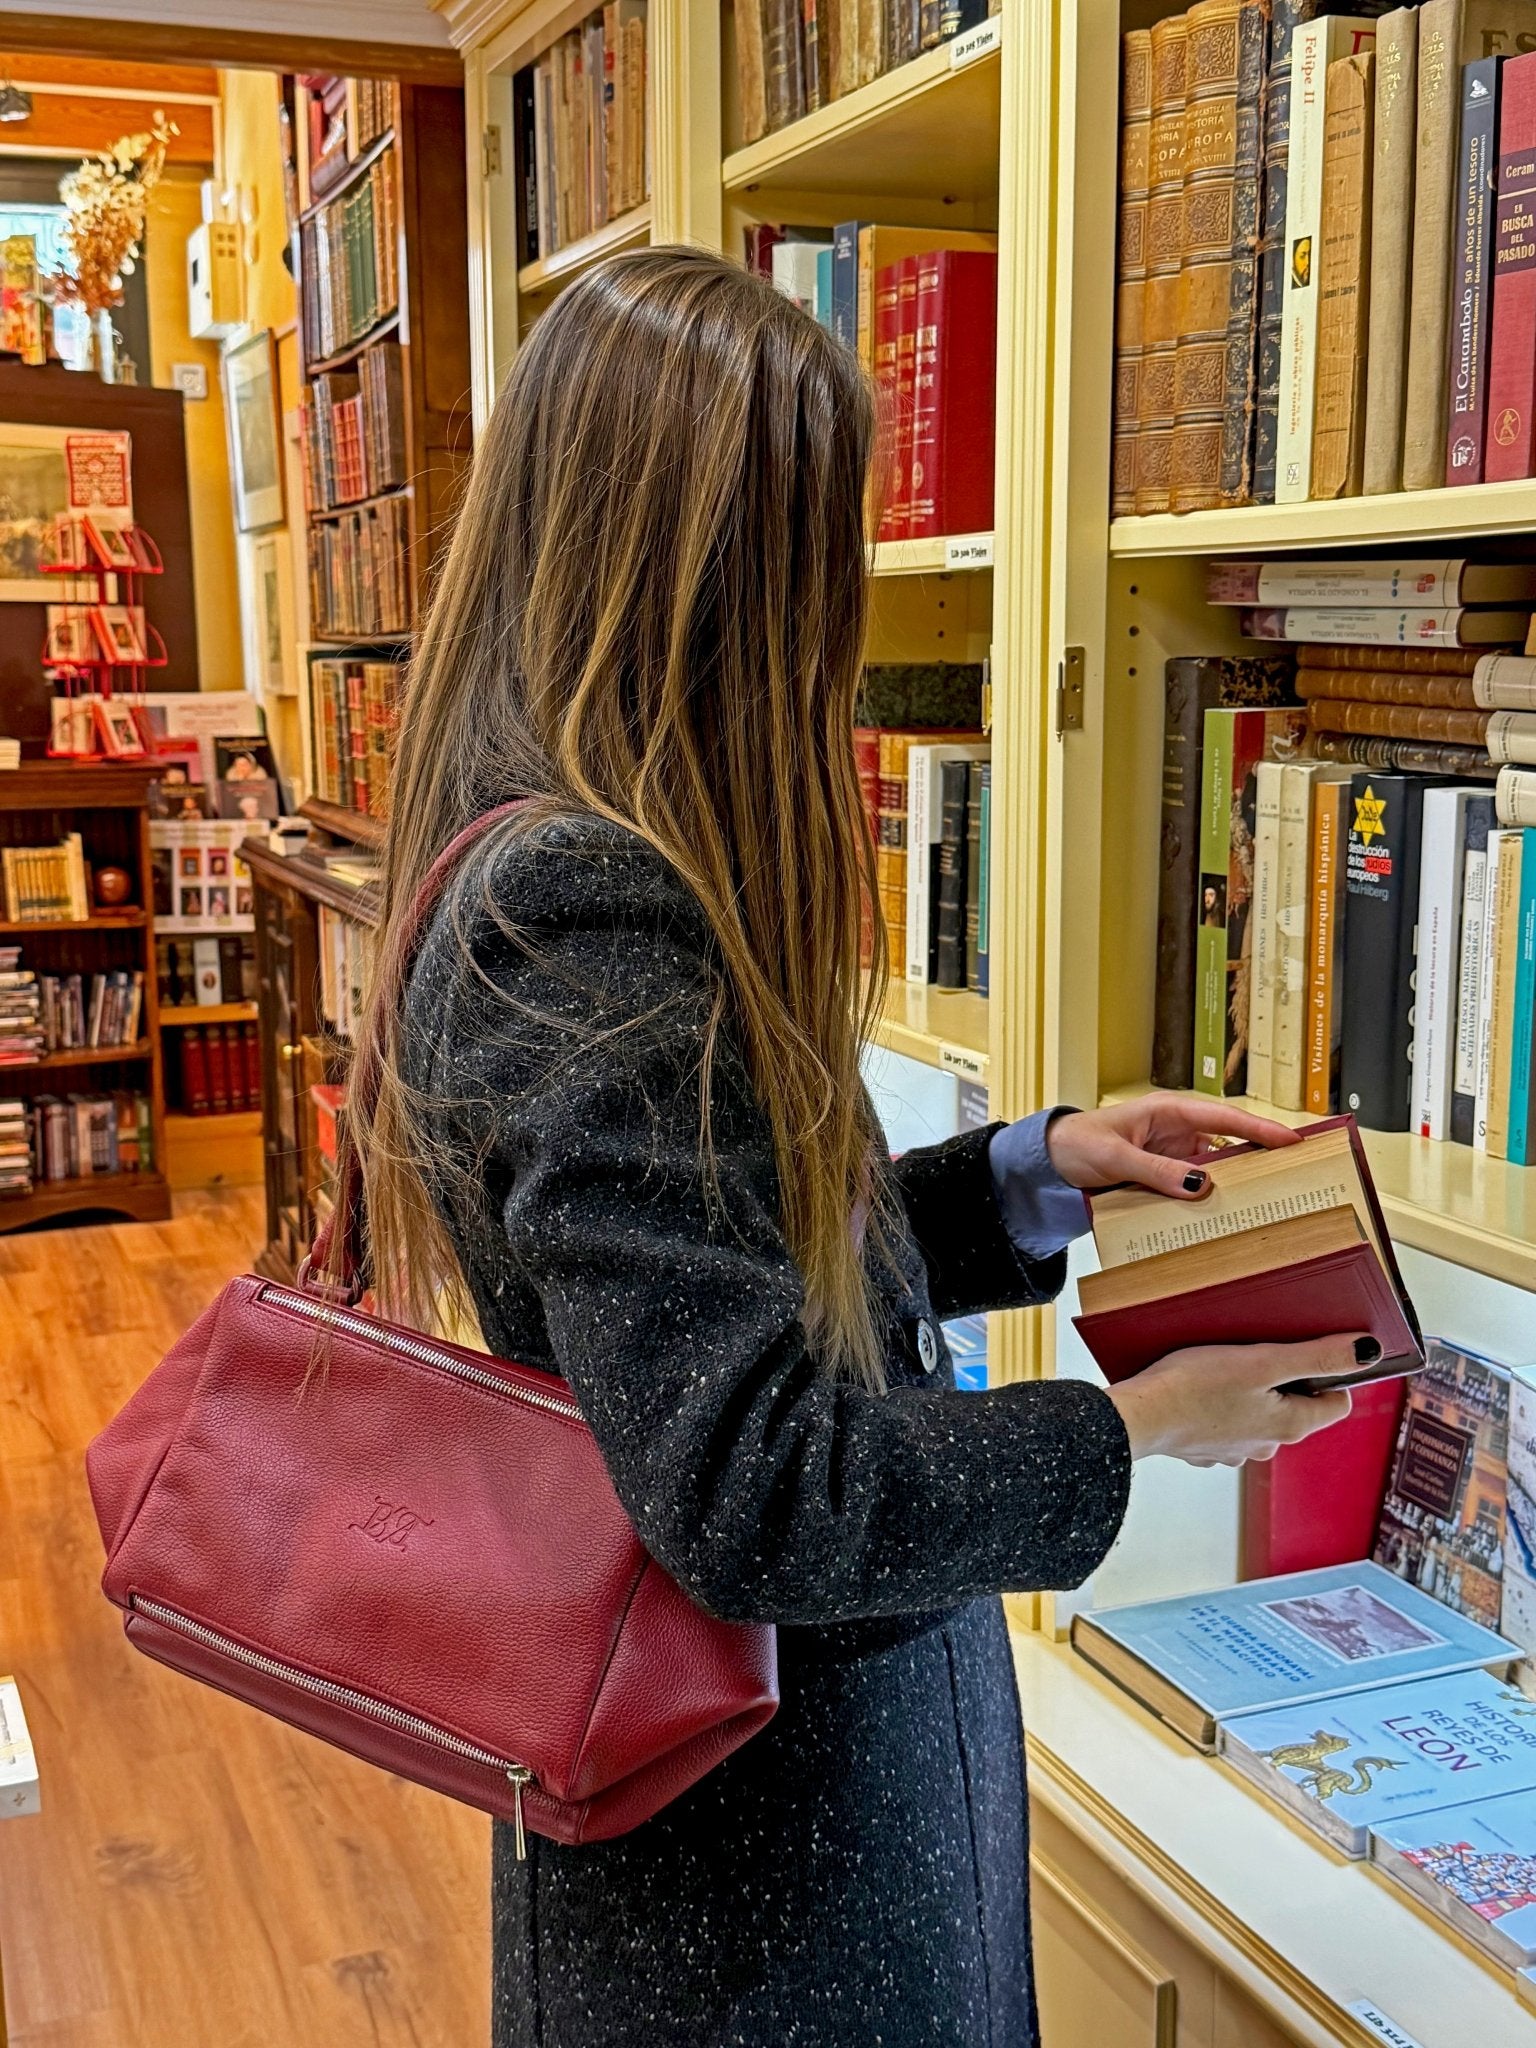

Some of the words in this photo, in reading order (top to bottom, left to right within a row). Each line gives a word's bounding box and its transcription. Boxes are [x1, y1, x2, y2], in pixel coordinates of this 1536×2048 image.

[956, 46, 965, 57] Lib
[976, 32, 994, 48] Viajes
[1301, 37, 1316, 84] Felipe
[1304, 91, 1315, 104] II
[1468, 137, 1479, 182] tesoro
[1506, 163, 1535, 179] Ceram
[1468, 186, 1477, 205] un
[1465, 208, 1476, 226] de
[1514, 203, 1524, 214] EN
[1501, 214, 1534, 234] BUSCA
[1465, 226, 1475, 263] años
[1510, 233, 1524, 244] DEL
[1497, 243, 1536, 264] PASADO
[1469, 378, 1477, 396] Luisa
[1474, 253, 1483, 284] Eduardo
[1479, 134, 1487, 192] (coordinadores)
[1465, 269, 1473, 284] 50
[1457, 288, 1473, 390] Carambolo
[1456, 393, 1467, 413] El
[951, 550, 960, 558] Lib
[970, 547, 988, 558] Viajes
[1348, 828, 1358, 842] La
[1318, 813, 1331, 884] hispánica
[1348, 842, 1390, 858] destrucción
[1346, 868, 1380, 883] europeos
[1361, 883, 1390, 902] Hilberg
[1317, 888, 1329, 968] monarquía
[1314, 973, 1325, 986] la
[1463, 945, 1472, 993] MARINOS
[1314, 991, 1325, 1008] de
[1460, 999, 1470, 1052] RECURSOS
[1312, 1013, 1324, 1073] Visiones
[1467, 1005, 1477, 1069] SOCIEDADES
[944, 1052, 952, 1062] Lib
[962, 1058, 978, 1072] Viajes
[1191, 1606, 1207, 1617] EN
[1207, 1618, 1221, 1627] EL
[1196, 1622, 1212, 1634] EN
[1211, 1634, 1226, 1643] EL
[1204, 1604, 1218, 1614] LA
[1258, 1642, 1316, 1680] AERONAVAL
[1462, 1716, 1488, 1729] DE
[1482, 1730, 1514, 1747] LOS
[1464, 1700, 1536, 1749] HISTORI
[1381, 1716, 1483, 1772] LEÓN
[1420, 1709, 1484, 1745] REYES
[1476, 1745, 1513, 1764] DE
[1362, 2012, 1384, 2027] Lib
